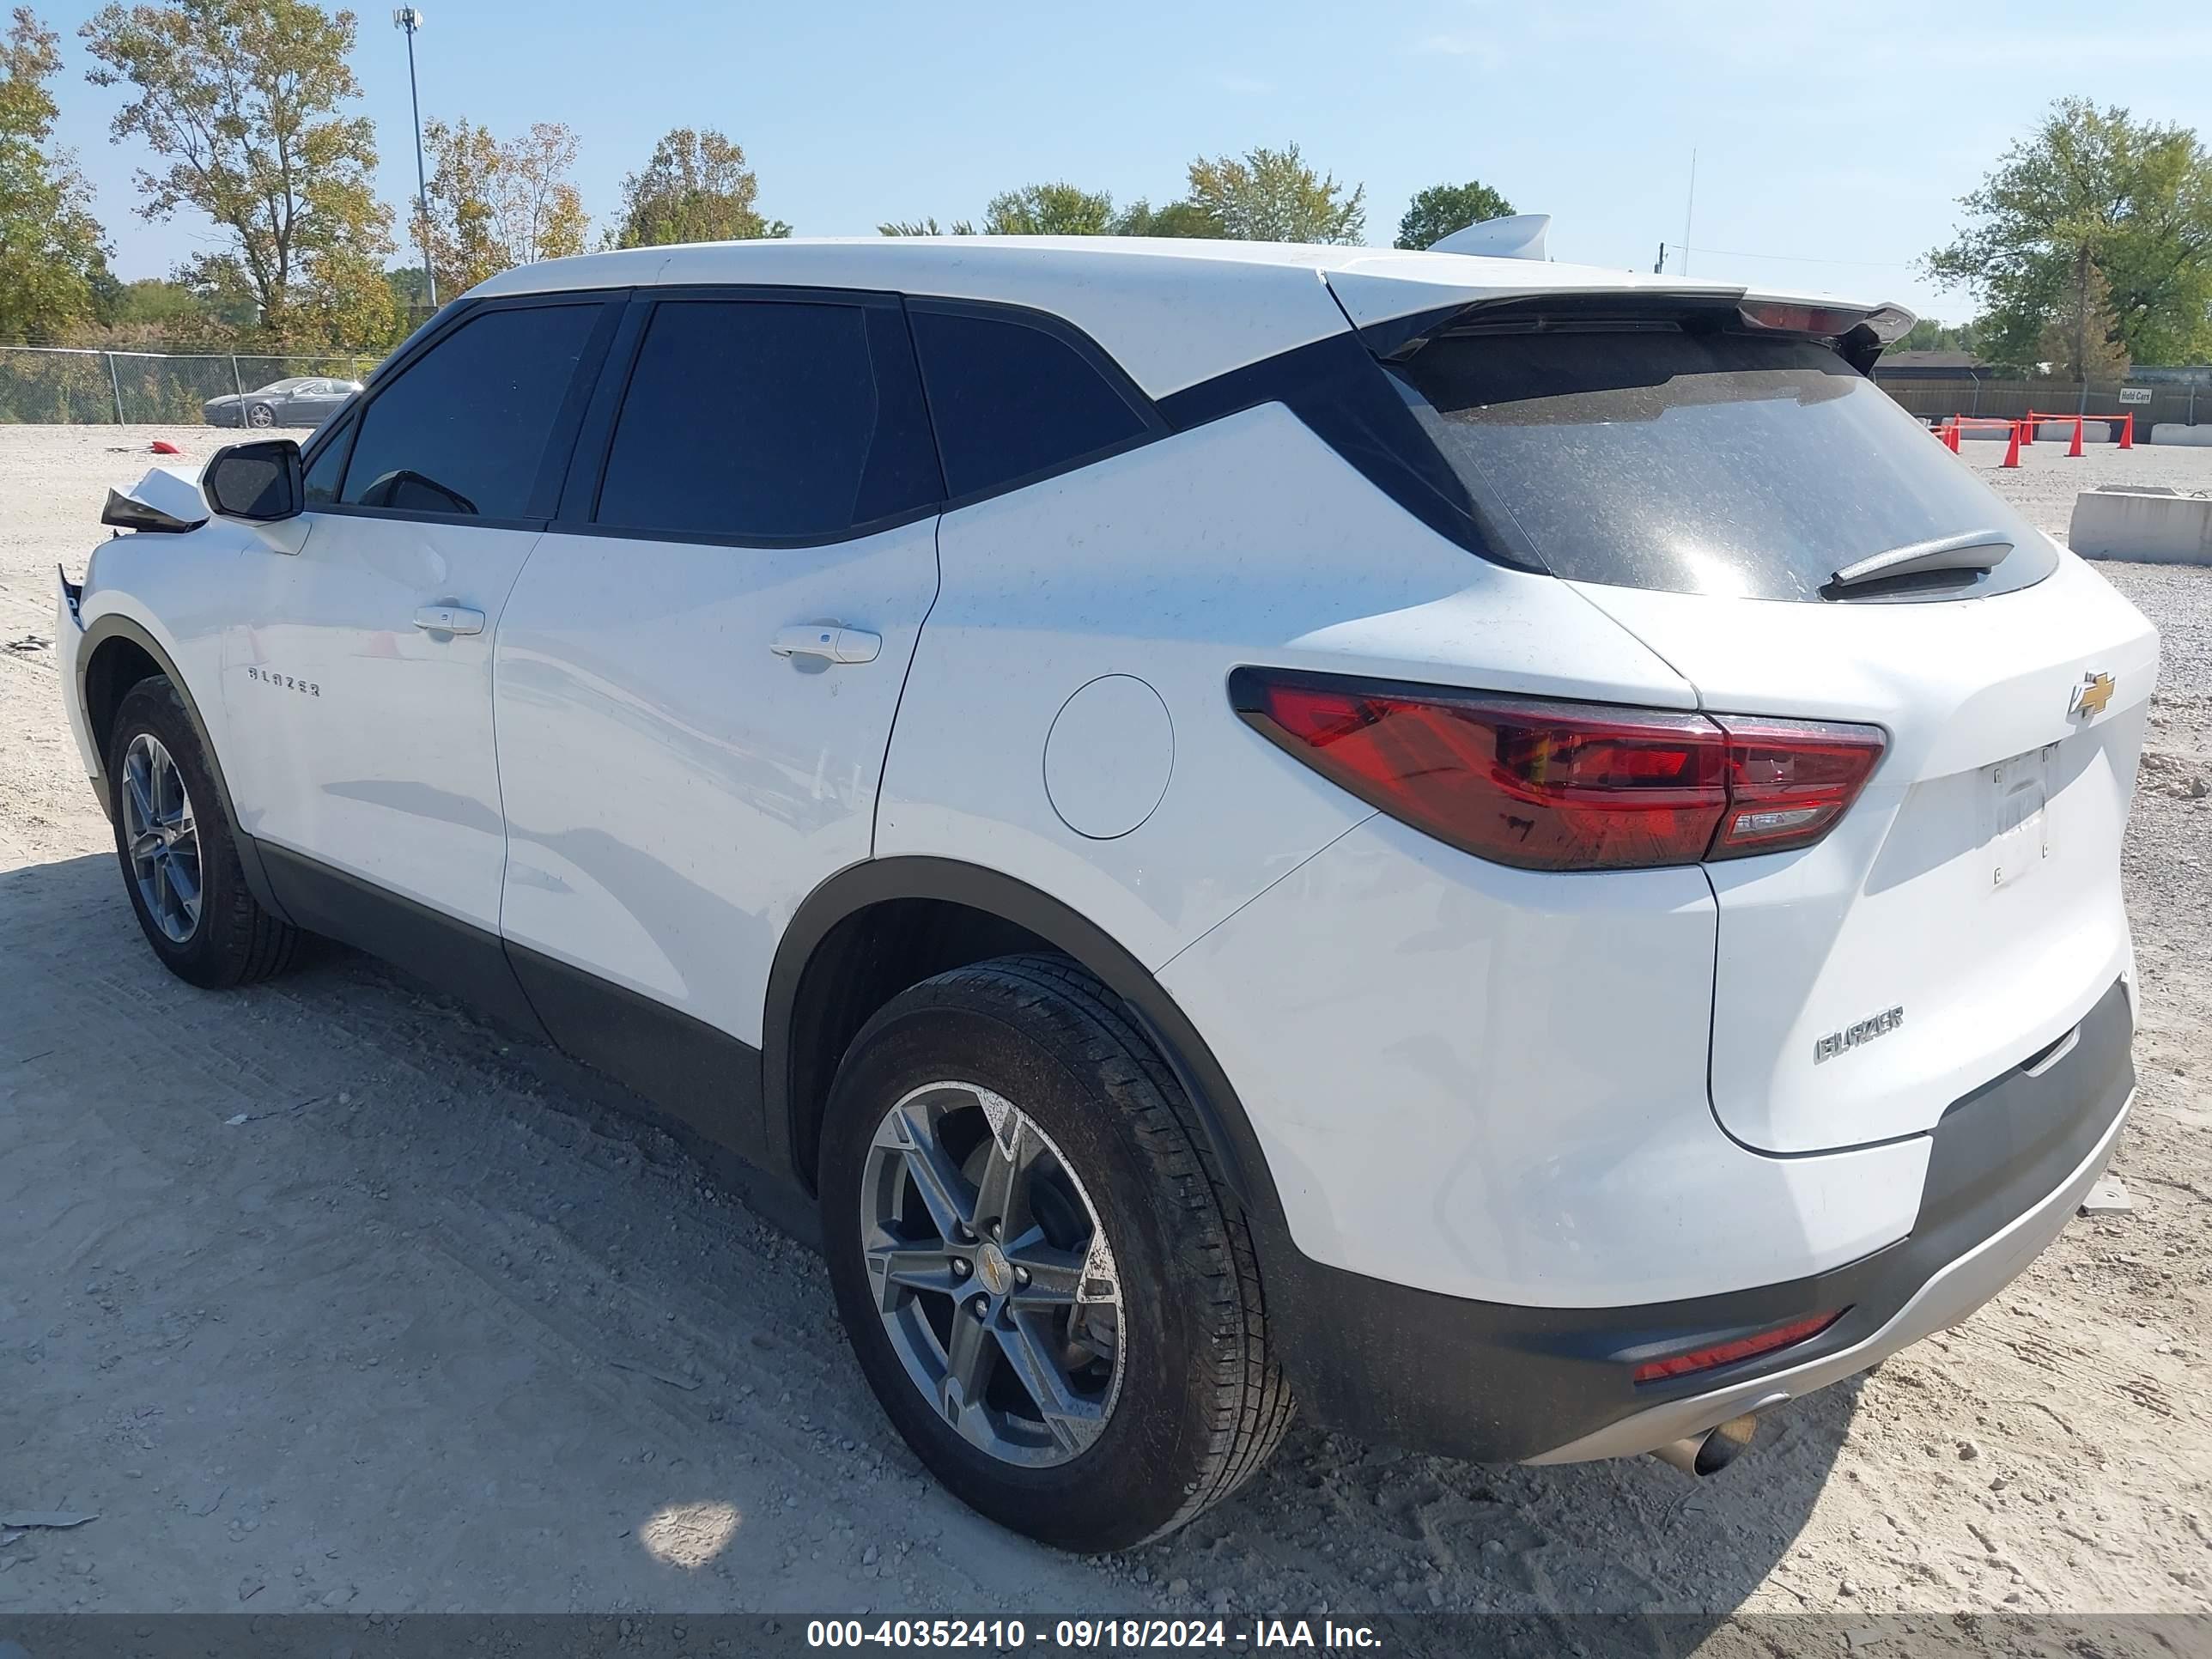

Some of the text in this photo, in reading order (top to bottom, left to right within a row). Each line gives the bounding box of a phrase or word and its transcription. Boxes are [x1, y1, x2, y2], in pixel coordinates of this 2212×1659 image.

[2136, 392, 2151, 401] Cars
[247, 666, 320, 697] BLAZER
[1814, 1005, 1904, 1066] BLAZER
